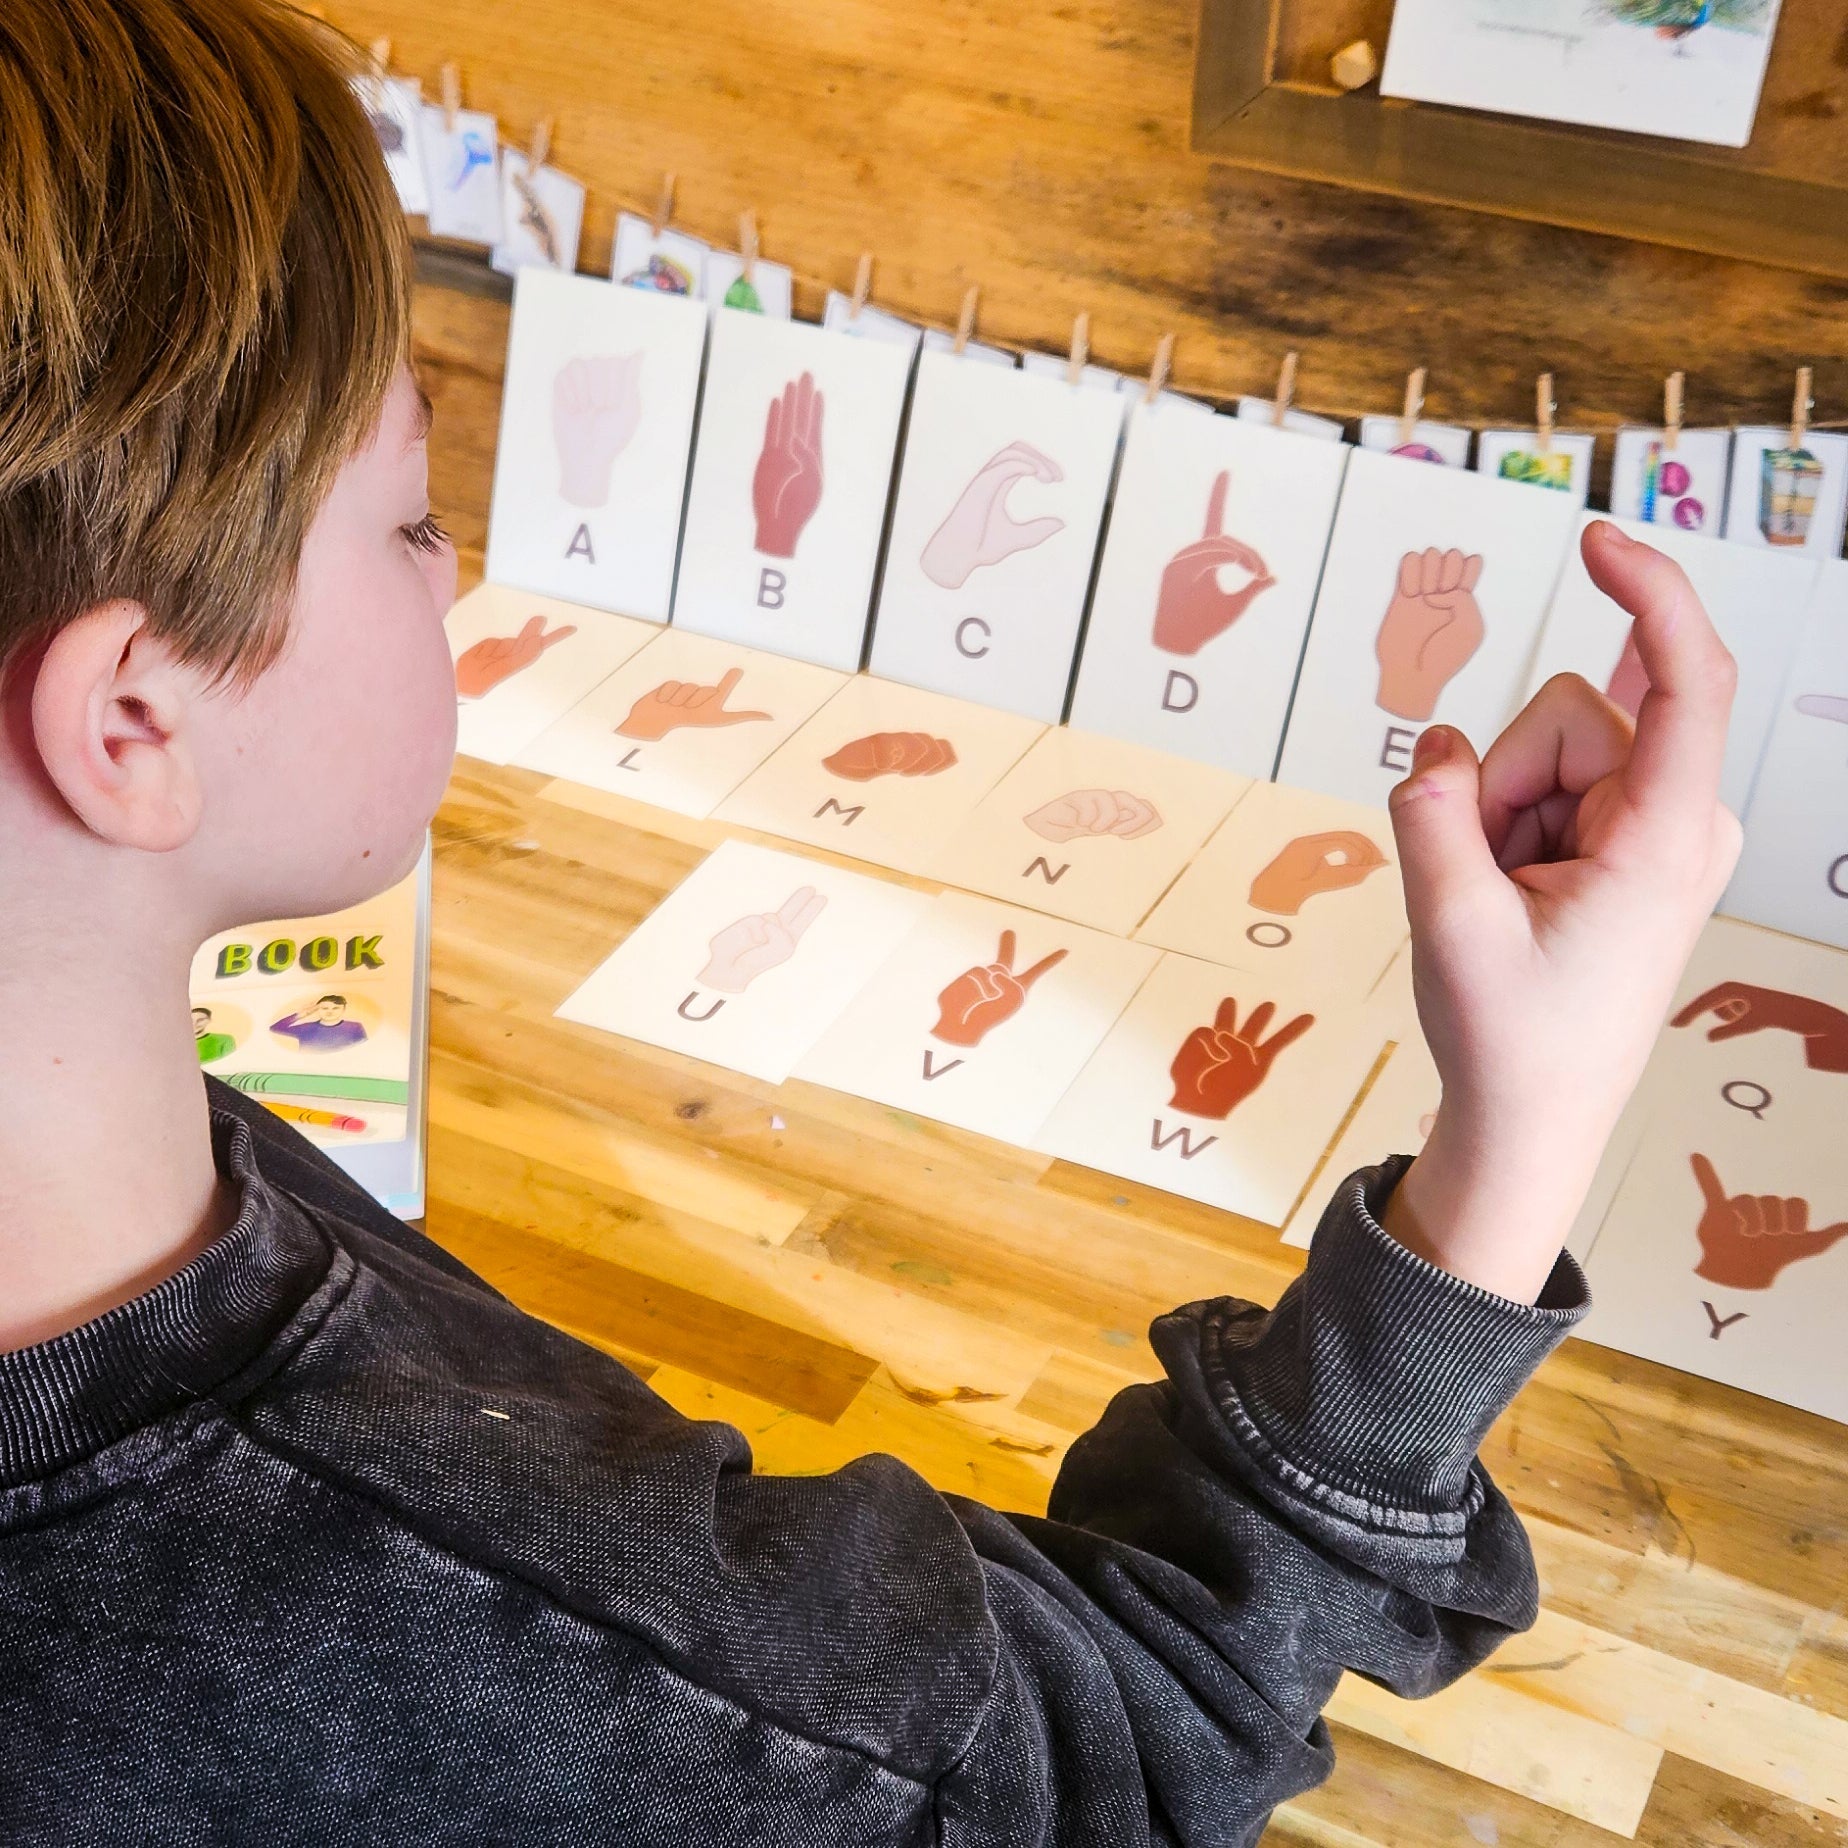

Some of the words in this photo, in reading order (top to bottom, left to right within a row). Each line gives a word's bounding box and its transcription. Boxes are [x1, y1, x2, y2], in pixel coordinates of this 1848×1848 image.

[563, 522, 597, 566] A
[756, 567, 788, 611] B
[954, 616, 993, 661] C
[1160, 668, 1200, 715] D
[616, 747, 642, 772] L
[1378, 726, 1416, 773] E
[813, 797, 866, 827] M
[1021, 856, 1072, 886] N
[1245, 921, 1293, 949] O
[215, 934, 386, 980] BOOK
[676, 990, 727, 1022] U
[922, 1049, 965, 1082] V
[1720, 1080, 1773, 1121] Q
[1150, 1118, 1219, 1161] W
[1701, 1300, 1750, 1341] Y
